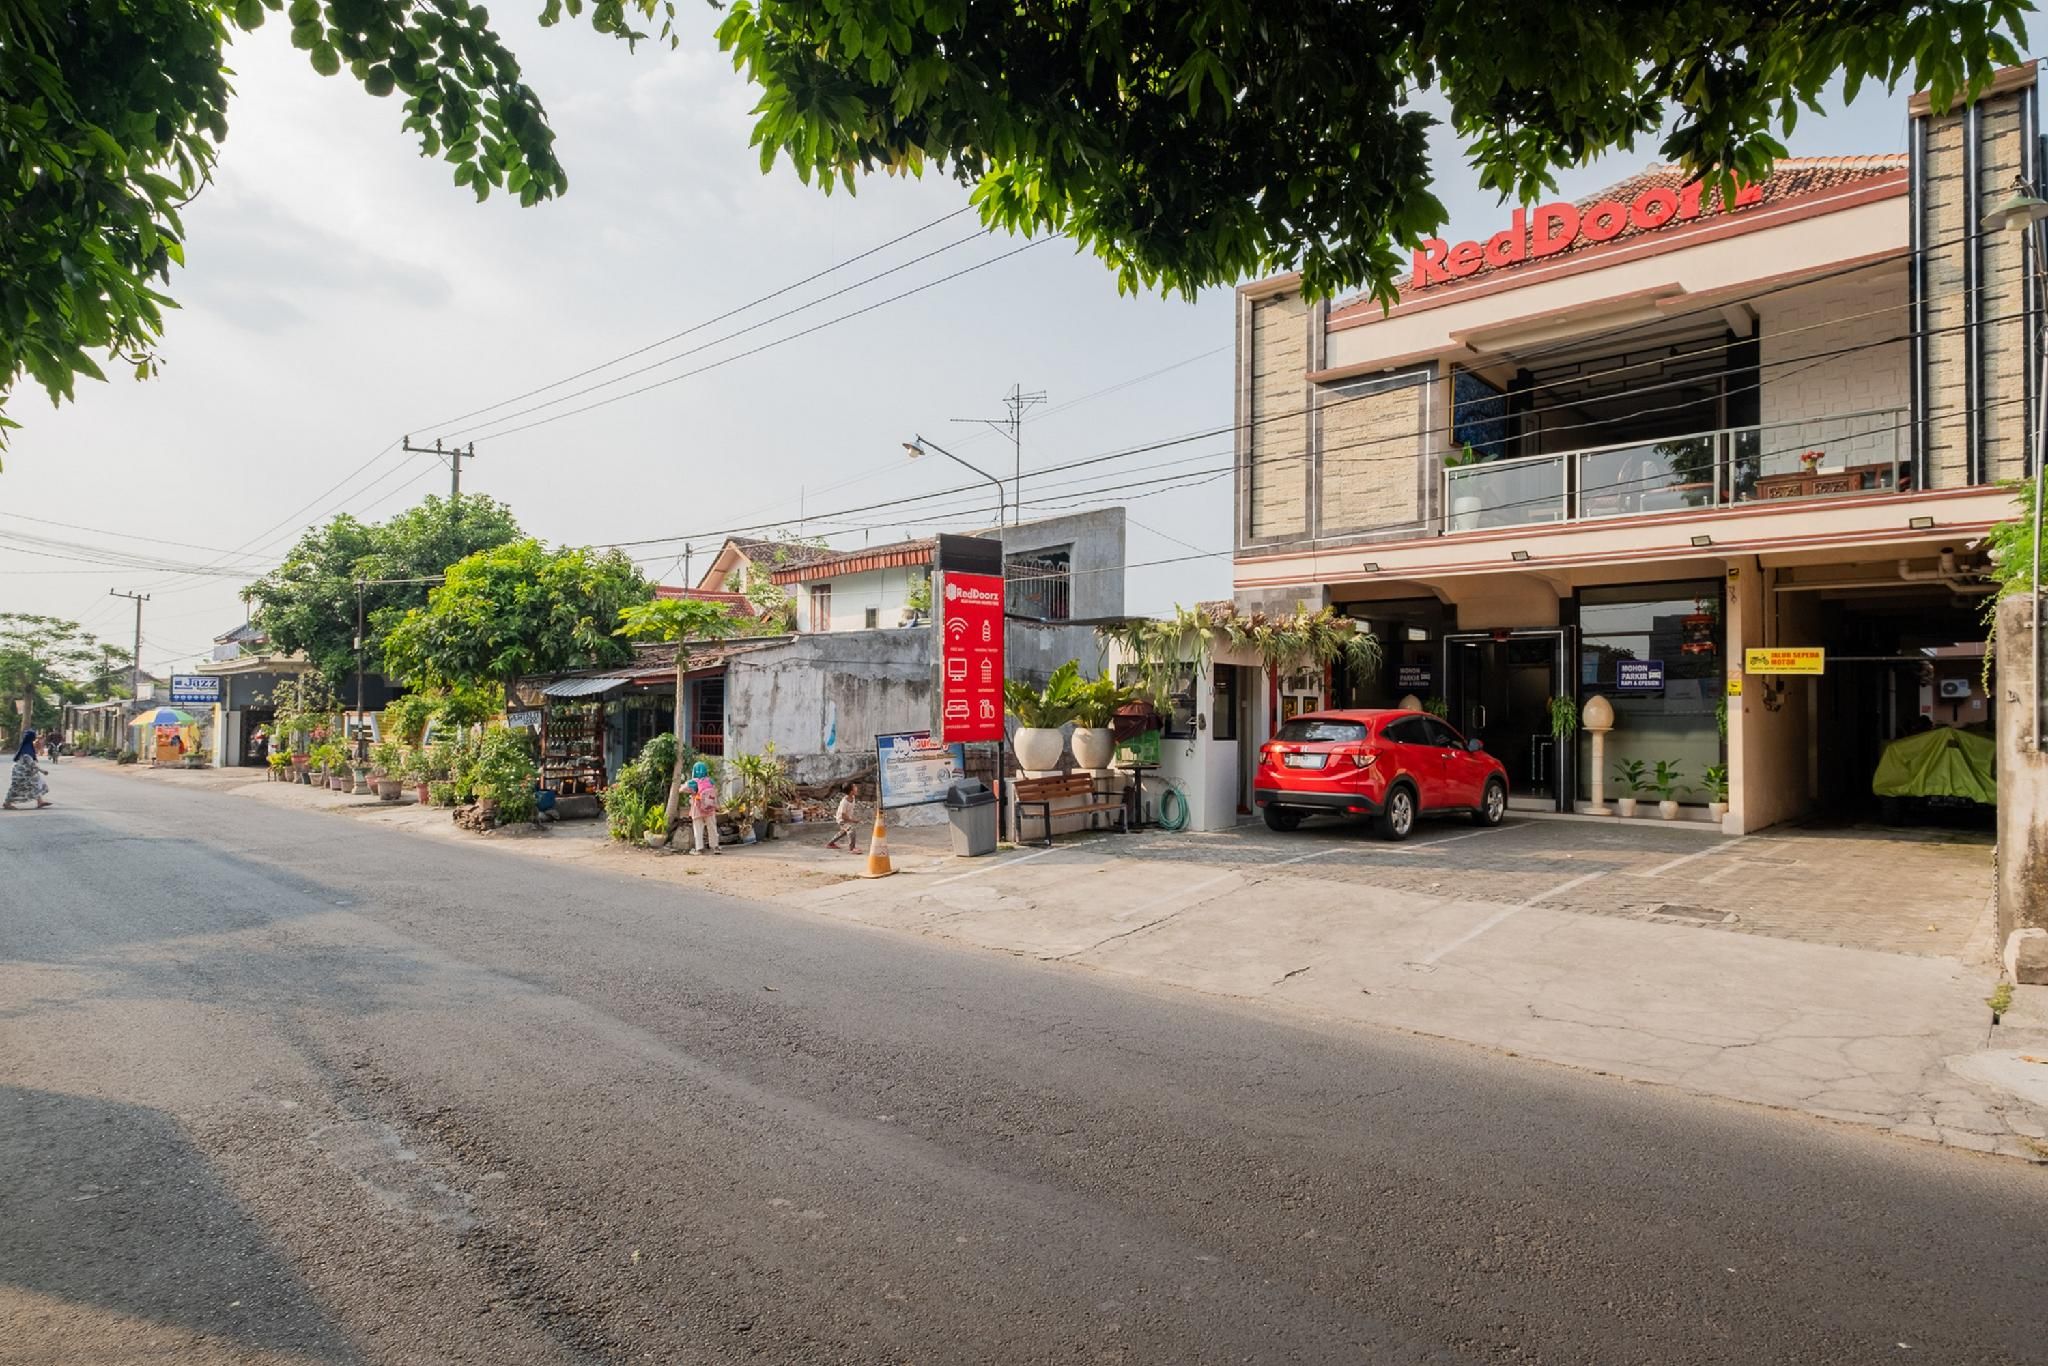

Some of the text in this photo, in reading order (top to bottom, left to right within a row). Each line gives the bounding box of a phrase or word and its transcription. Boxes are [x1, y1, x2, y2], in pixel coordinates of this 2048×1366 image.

[956, 587, 999, 600] RedDoorz
[1621, 664, 1648, 672] MOHON
[184, 678, 217, 688] Jazz
